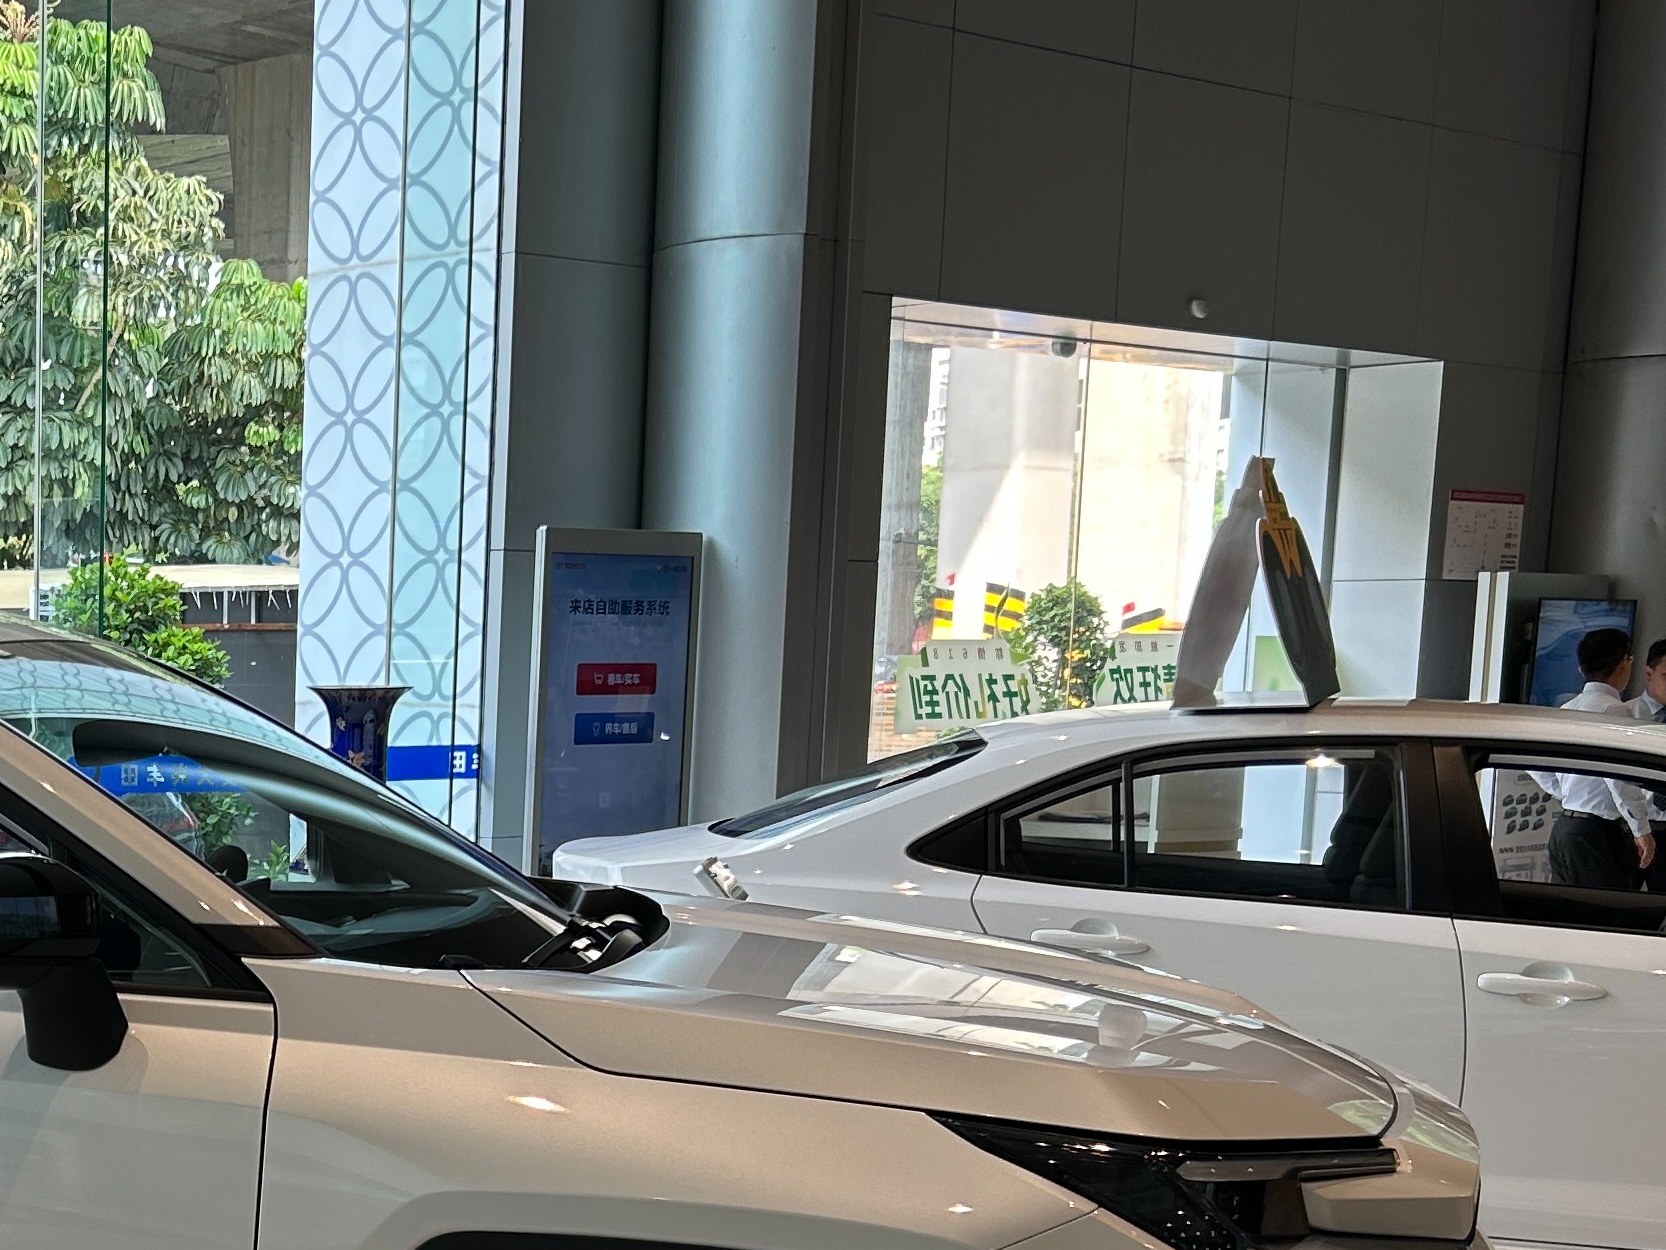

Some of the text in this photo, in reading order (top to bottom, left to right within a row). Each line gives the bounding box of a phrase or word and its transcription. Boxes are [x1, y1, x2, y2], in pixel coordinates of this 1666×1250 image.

[569, 598, 670, 617] 来店自助服务系统
